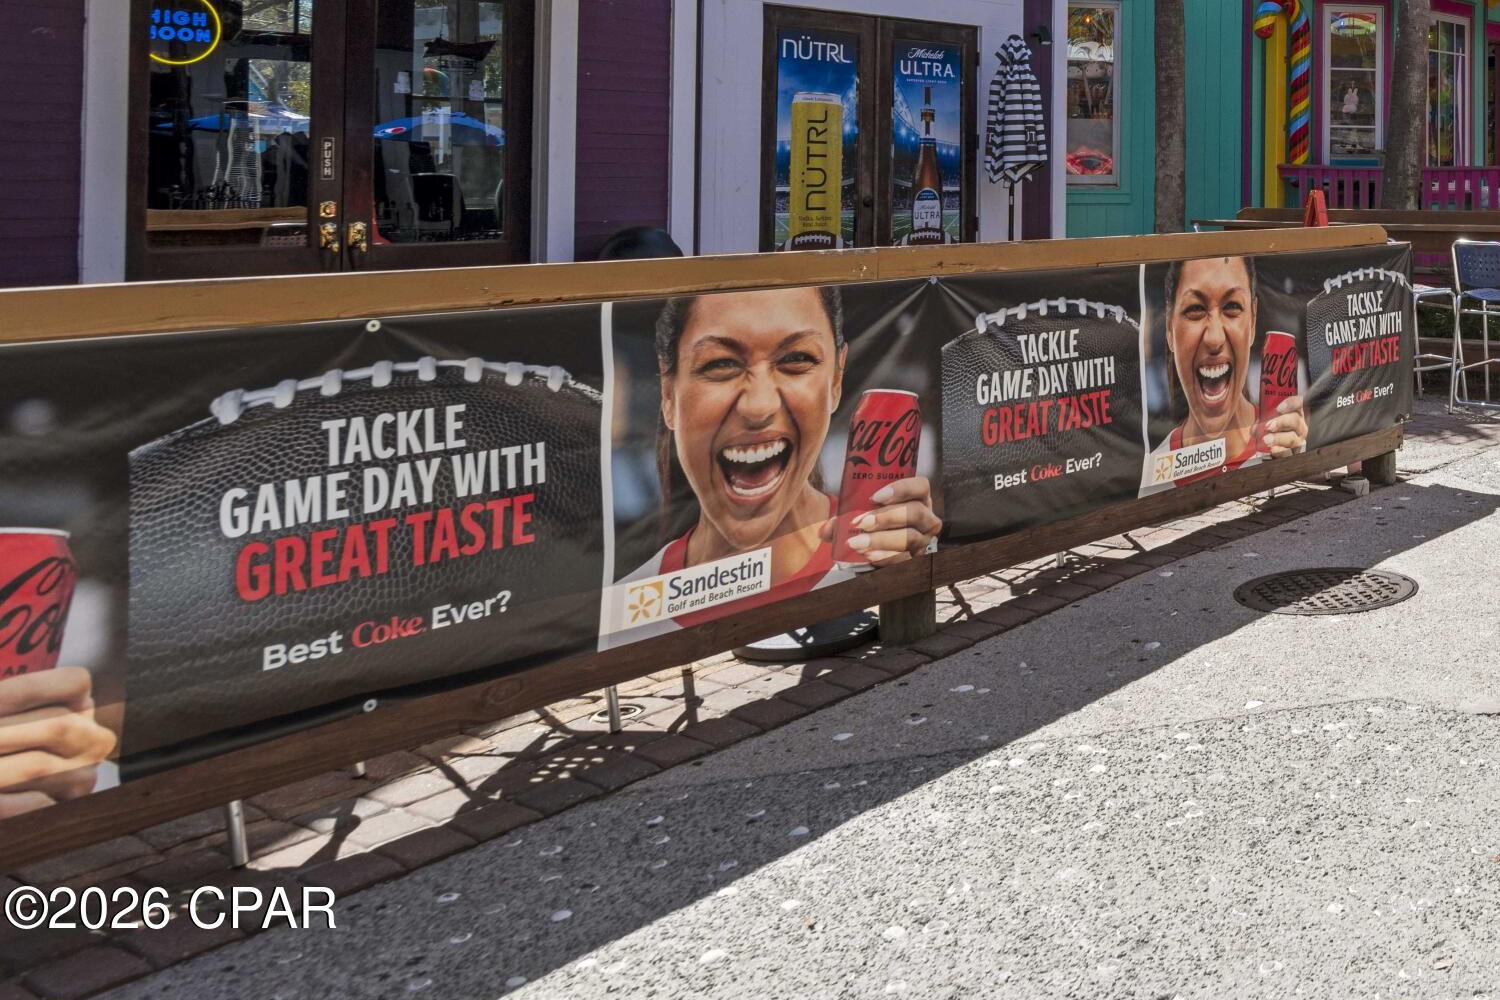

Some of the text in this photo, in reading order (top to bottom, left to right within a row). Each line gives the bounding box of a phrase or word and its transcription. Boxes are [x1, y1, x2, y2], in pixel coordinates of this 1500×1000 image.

[900, 60, 954, 77] ULTRA
[907, 48, 944, 60] Michelob
[323, 142, 332, 176] PUSH
[914, 211, 940, 220] ULTRA
[1347, 290, 1383, 316] TACKLE
[1325, 311, 1402, 346] GAME DAY WITH
[1017, 329, 1079, 364] TACKLE
[1332, 336, 1400, 376] GREAT TASTE
[976, 356, 1116, 405] GAME DAY WITH
[1337, 383, 1394, 408] Best Coke Ever?
[321, 404, 466, 467] TACKLE
[982, 390, 1112, 446] GREAT TASTE
[994, 452, 1103, 490] Best Coke Ever?
[1175, 444, 1222, 469] Sandestin
[219, 441, 546, 538] GAME DAY WITH
[235, 493, 535, 603] GREAT TASTE
[667, 580, 763, 613] Golf and Beach Resort
[668, 558, 763, 600] Sandestin
[262, 589, 512, 671] Best Coke Ever?
